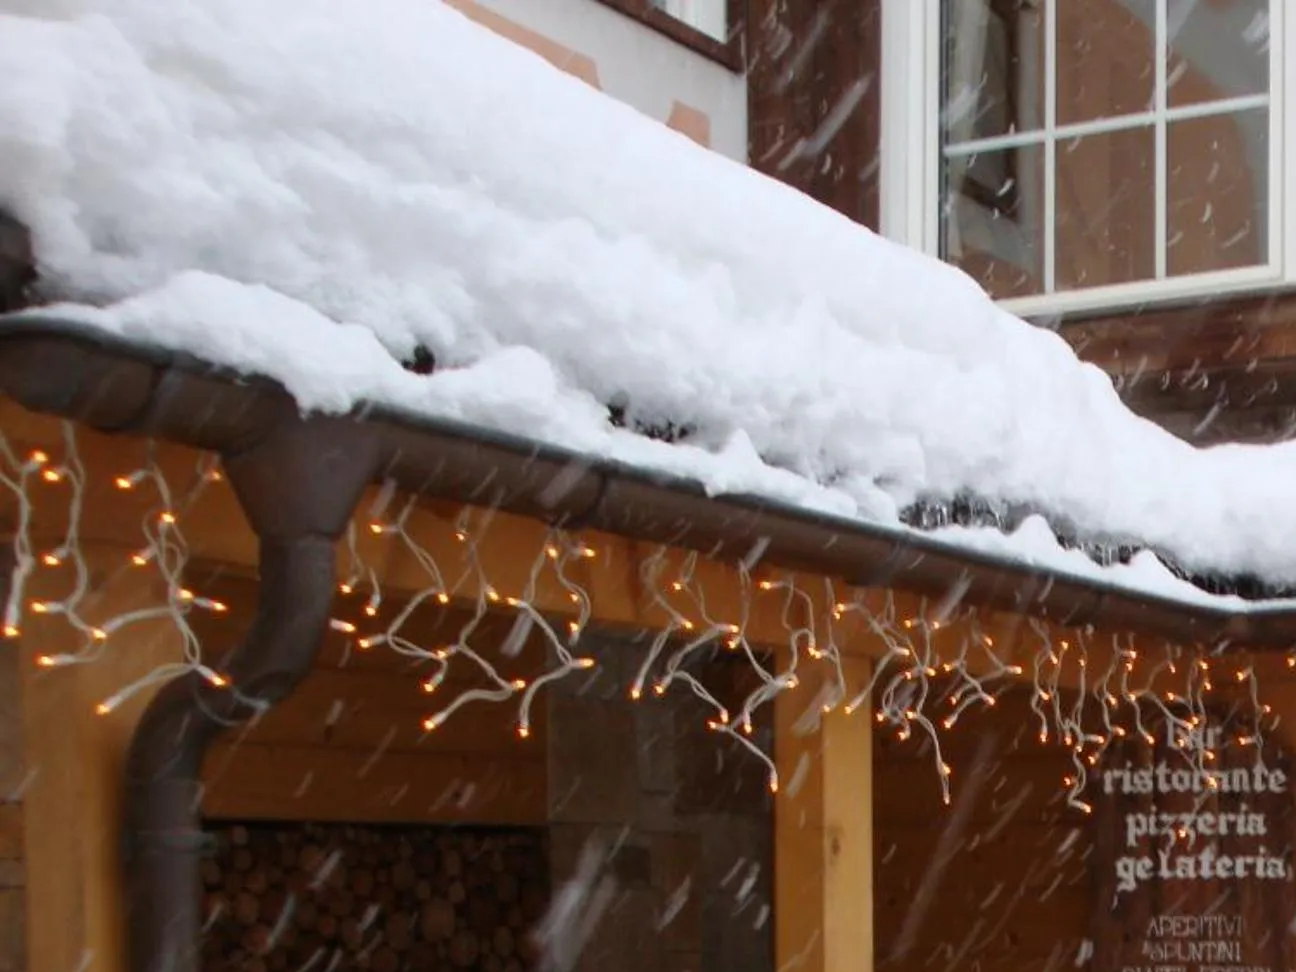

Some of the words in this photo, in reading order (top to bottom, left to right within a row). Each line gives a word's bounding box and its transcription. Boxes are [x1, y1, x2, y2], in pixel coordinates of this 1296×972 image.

[1103, 760, 1287, 794] ristorante
[1126, 804, 1268, 848] pizzeria
[1115, 847, 1287, 892] gelateria
[1147, 915, 1243, 937] APERITIVI
